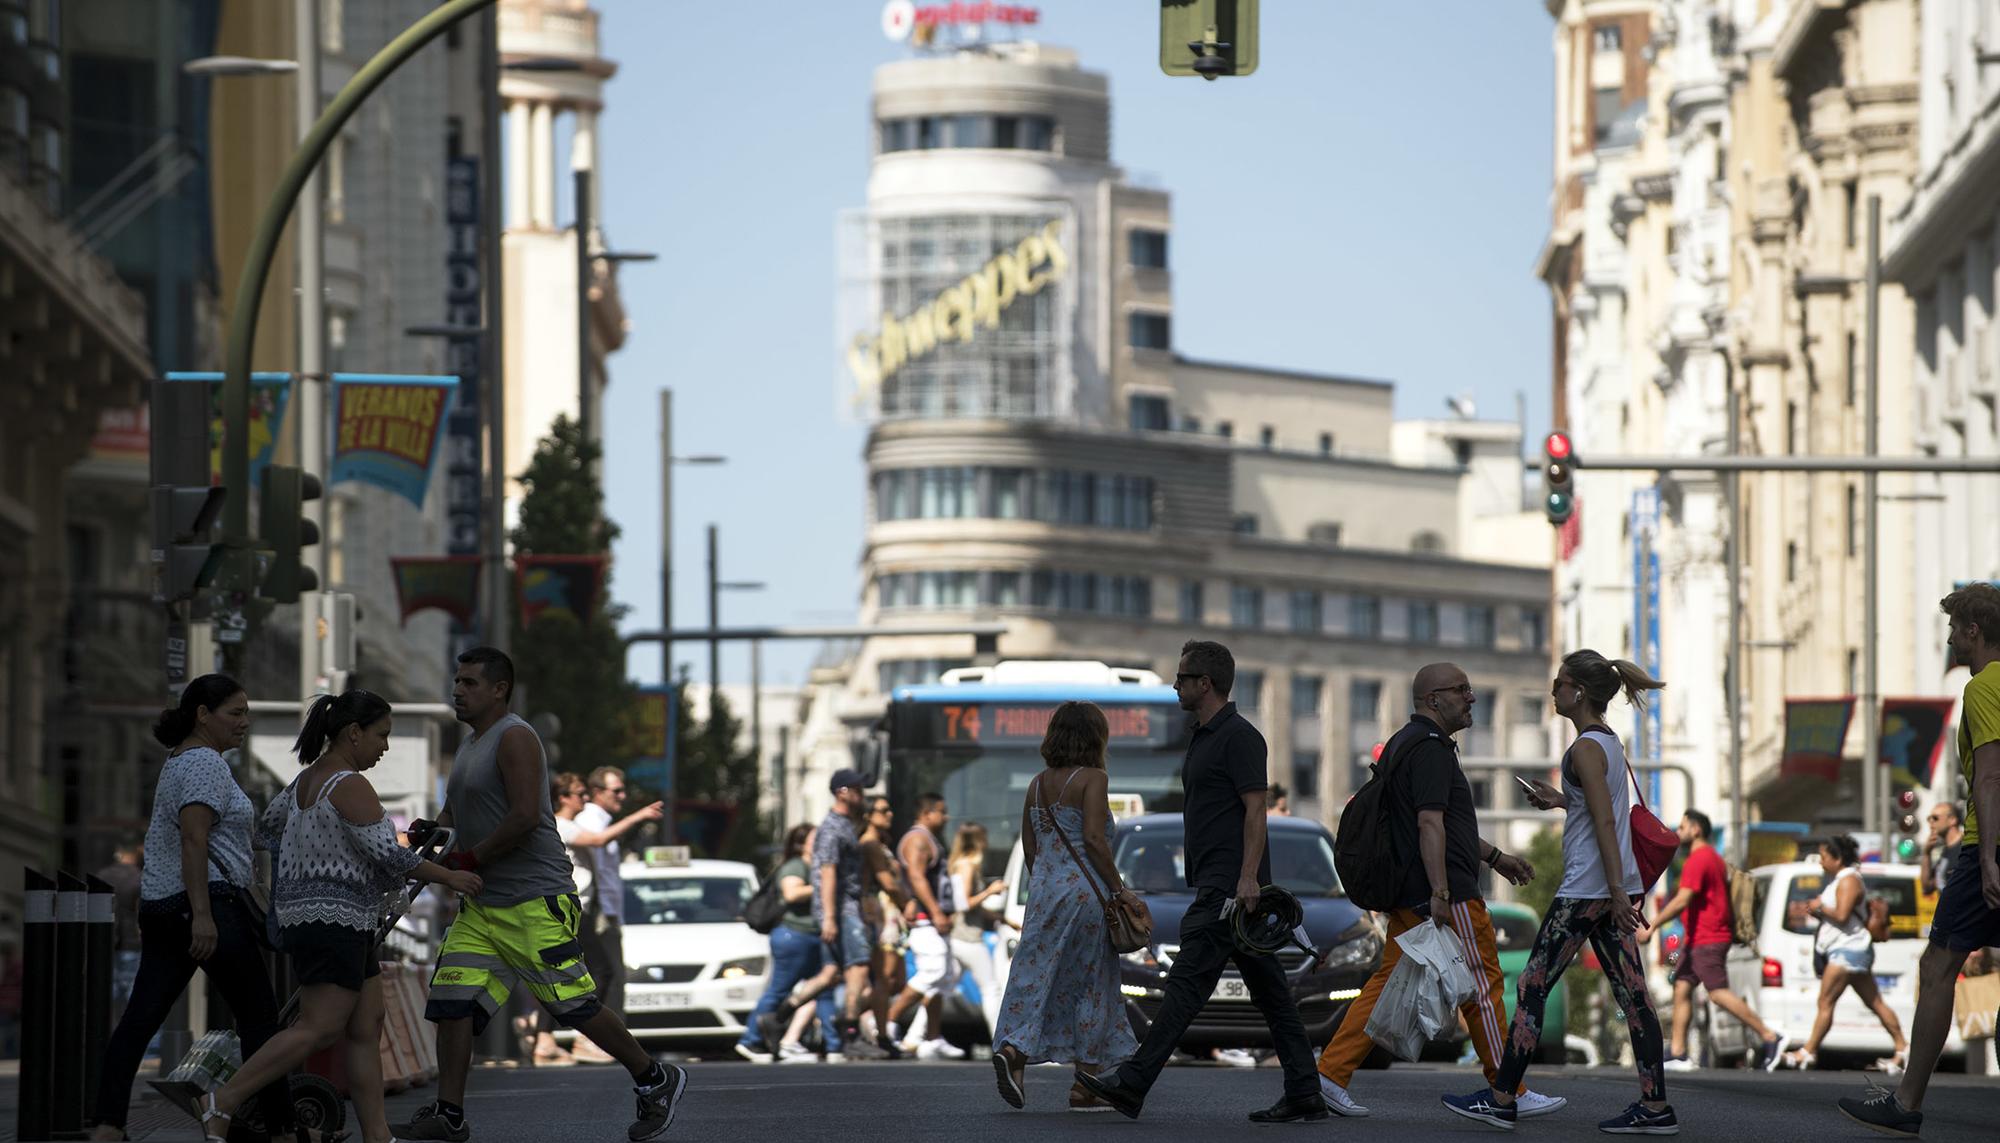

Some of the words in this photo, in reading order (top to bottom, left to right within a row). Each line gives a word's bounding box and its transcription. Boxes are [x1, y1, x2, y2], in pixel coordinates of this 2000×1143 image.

[343, 385, 438, 427] VERANOS
[361, 417, 381, 447] LA
[384, 418, 432, 460] VILLA
[943, 706, 982, 742] 74
